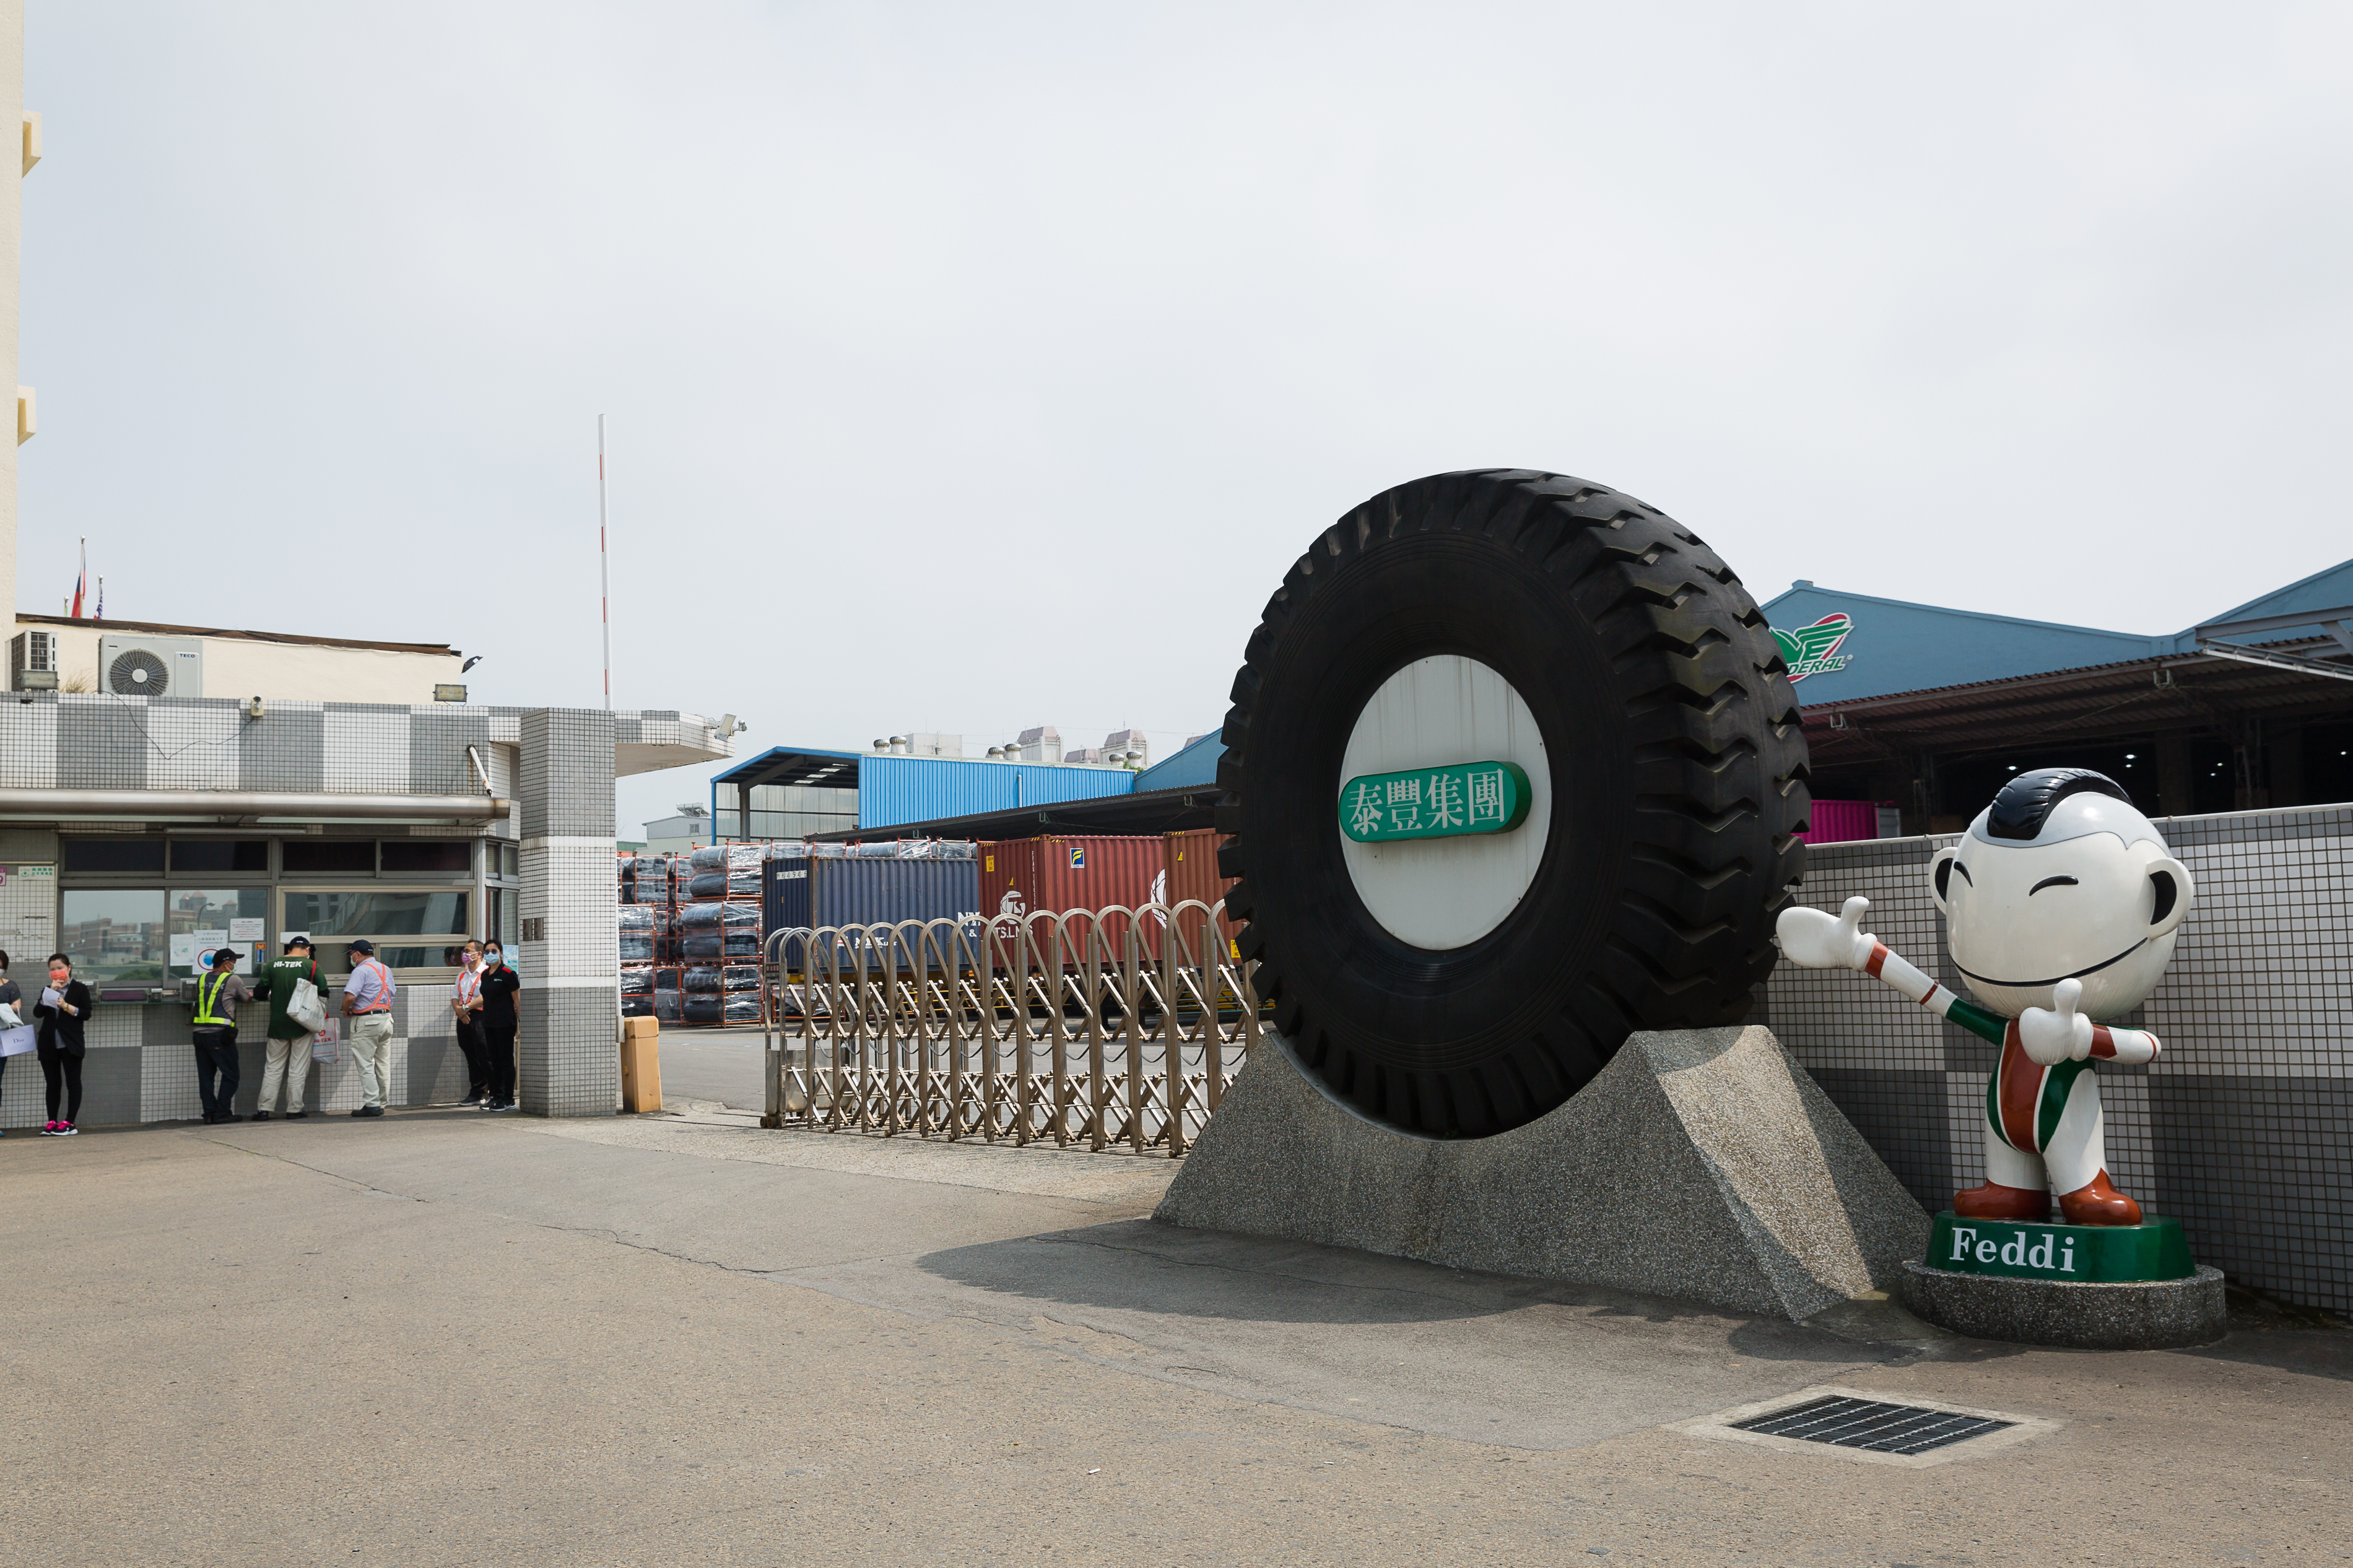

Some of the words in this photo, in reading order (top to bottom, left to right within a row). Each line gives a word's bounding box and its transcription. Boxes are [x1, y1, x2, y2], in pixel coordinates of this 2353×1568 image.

[1787, 657, 1845, 675] DERAL
[1347, 768, 1505, 836] 泰豐集團
[1949, 1227, 2076, 1271] Feddi
